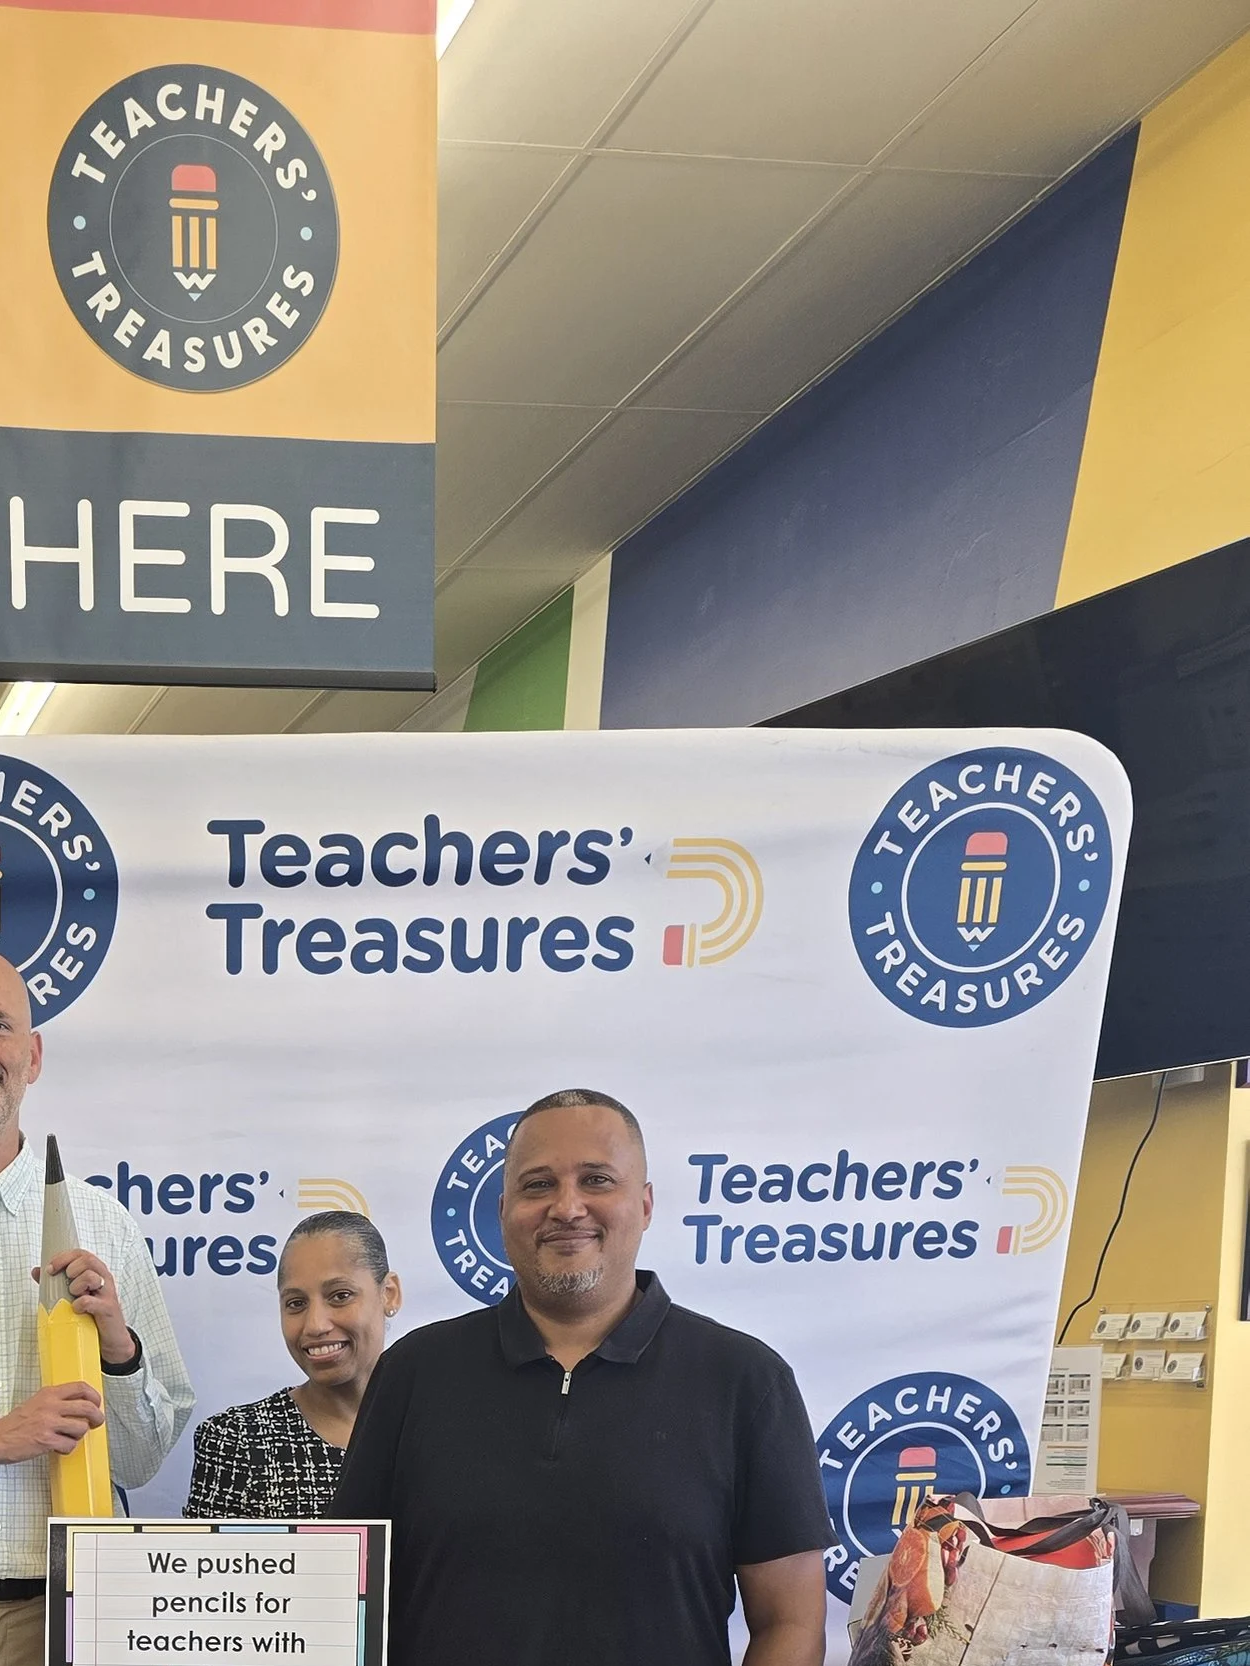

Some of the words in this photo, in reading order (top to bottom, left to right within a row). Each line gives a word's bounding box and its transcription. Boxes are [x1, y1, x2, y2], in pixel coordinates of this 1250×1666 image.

[71, 83, 317, 201] TEACHERS'
[71, 250, 316, 373] TREASURES
[9, 496, 380, 618] HERE
[873, 762, 1099, 861] TEACHERS'
[206, 814, 634, 888] Teachers'
[205, 903, 636, 975] Treasures
[865, 911, 1086, 1013] TREASURES
[688, 1149, 979, 1204] Teachers'
[682, 1214, 980, 1265] Treasures
[147, 1552, 187, 1574] We
[197, 1552, 296, 1578] pushed
[152, 1592, 246, 1617] pencils
[255, 1592, 291, 1614] for
[127, 1629, 243, 1652] teachers
[251, 1631, 306, 1654] with
